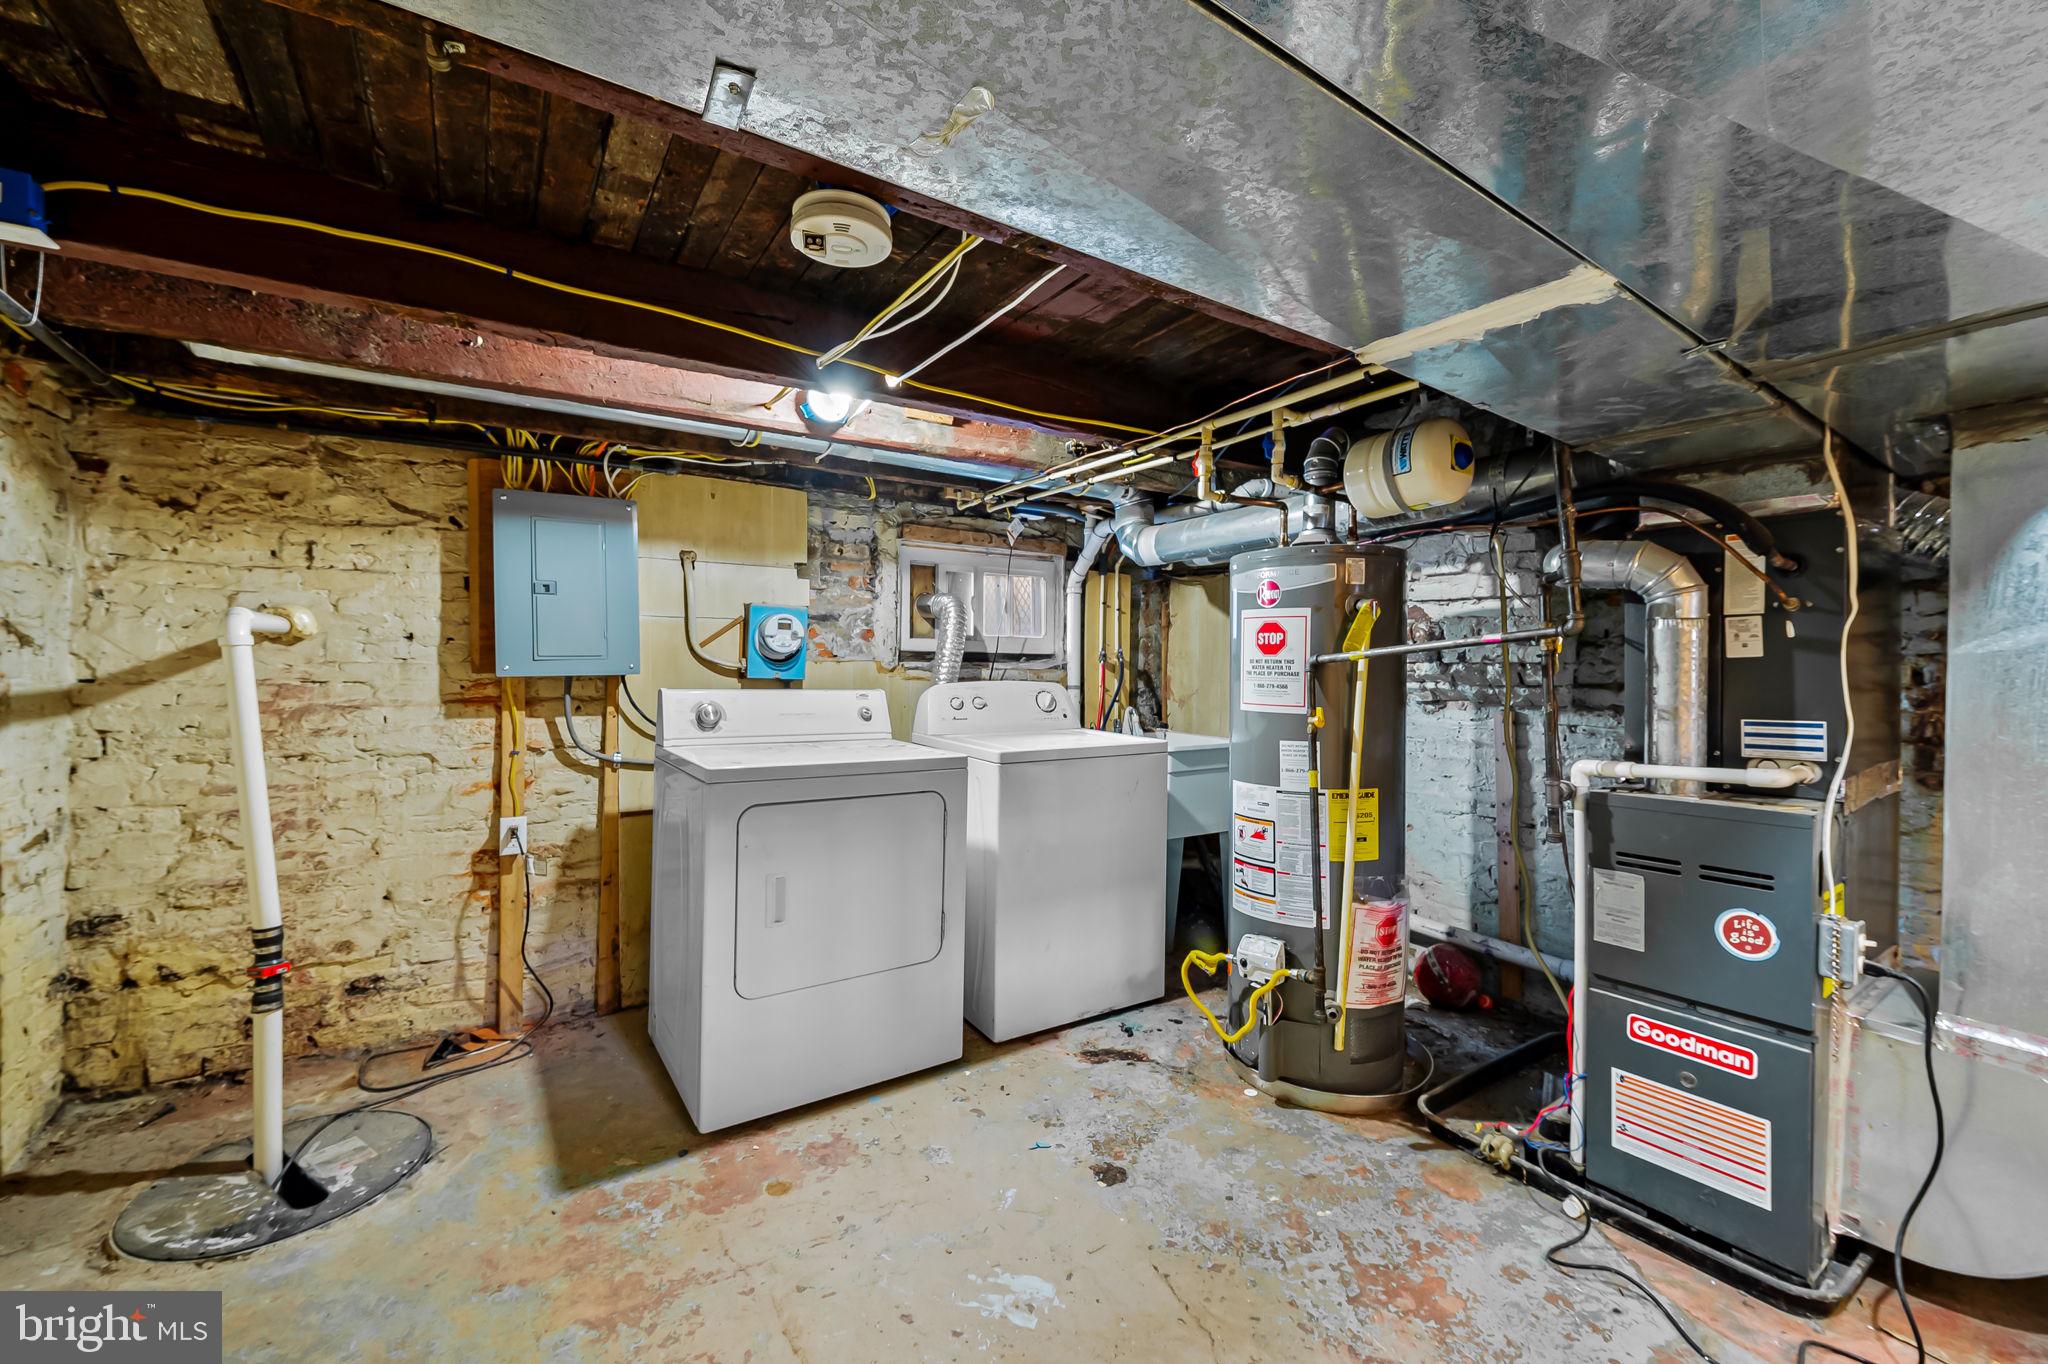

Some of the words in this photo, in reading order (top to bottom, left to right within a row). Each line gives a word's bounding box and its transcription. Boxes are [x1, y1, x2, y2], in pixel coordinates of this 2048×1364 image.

[1258, 632, 1285, 645] STOP
[1733, 919, 1760, 931] Life
[1742, 928, 1755, 937] is
[1632, 1020, 1750, 1070] Goodman
